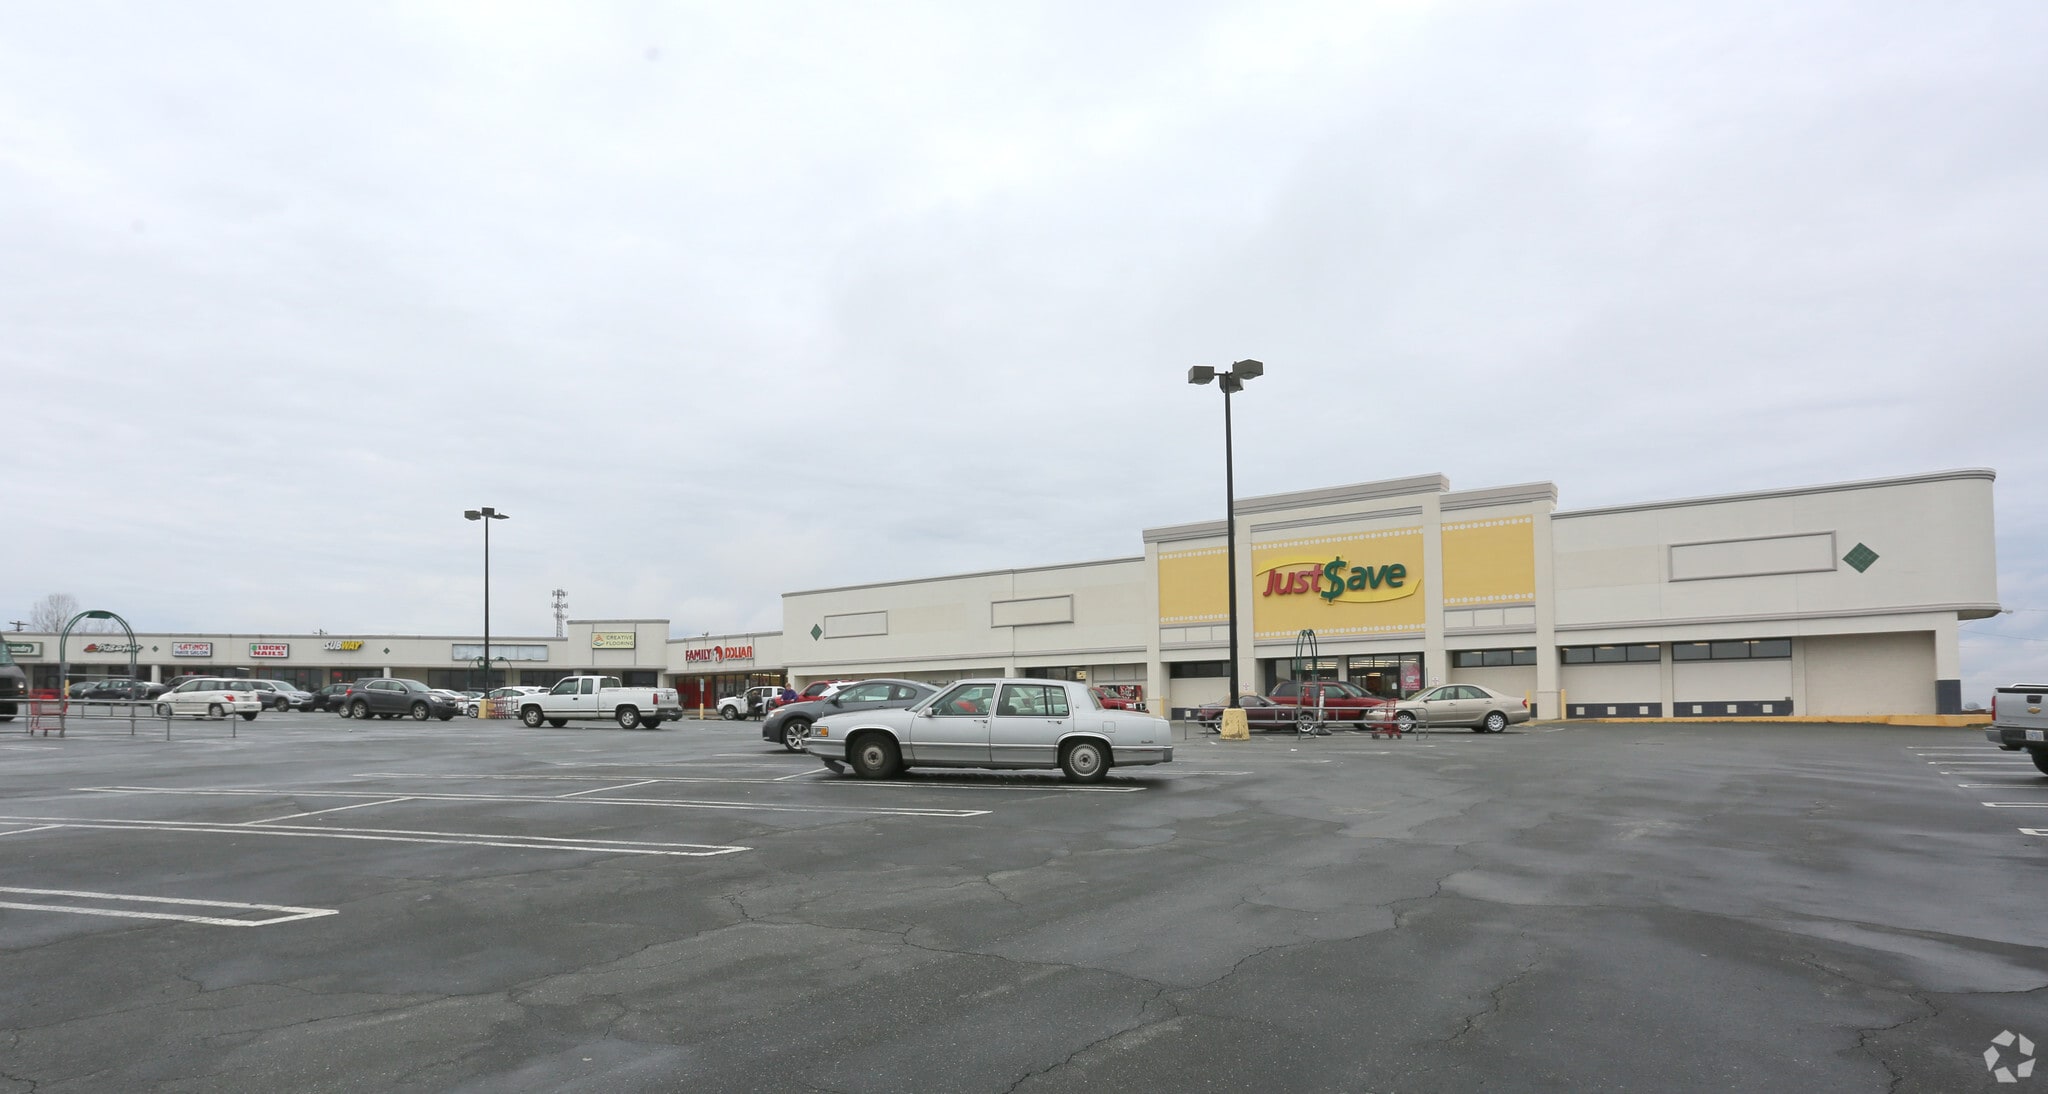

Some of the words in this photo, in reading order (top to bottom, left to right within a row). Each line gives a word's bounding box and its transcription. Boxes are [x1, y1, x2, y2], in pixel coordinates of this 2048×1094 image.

[324, 640, 364, 650] SUBWAY
[685, 648, 712, 662] FAMILY
[725, 645, 753, 659] DOLLAR
